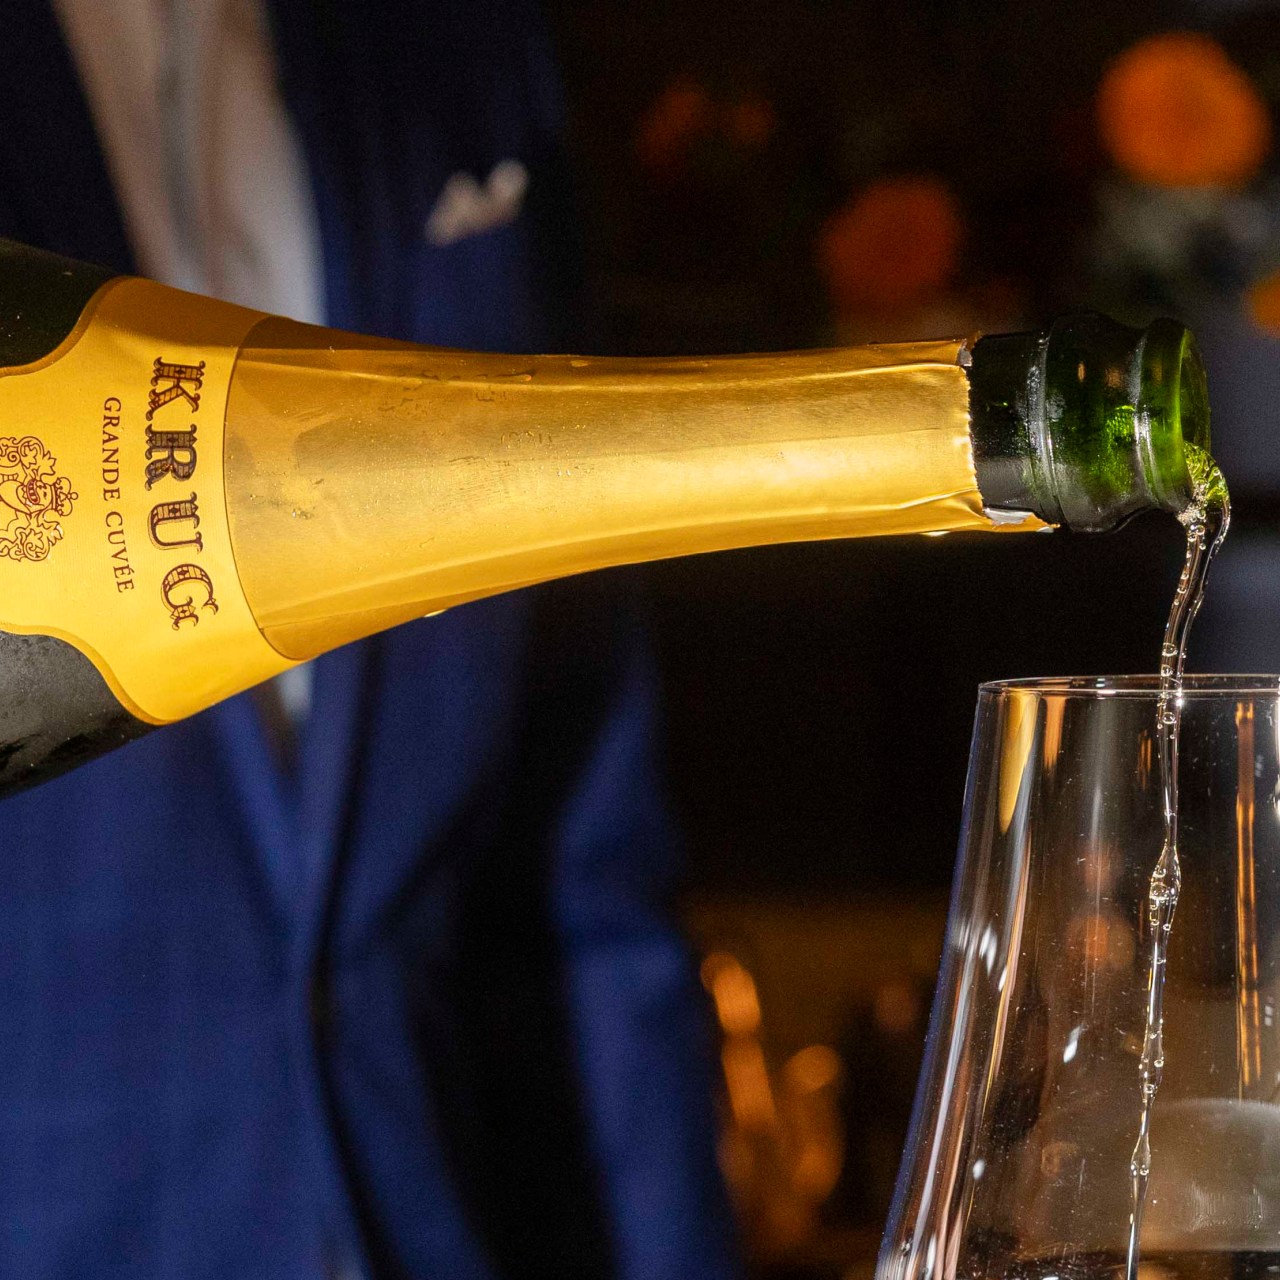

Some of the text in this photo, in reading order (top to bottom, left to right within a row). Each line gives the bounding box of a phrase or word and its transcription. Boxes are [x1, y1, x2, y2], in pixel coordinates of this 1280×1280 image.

[101, 396, 136, 594] GRANDE CUVÉE
[145, 356, 220, 632] KRUG
